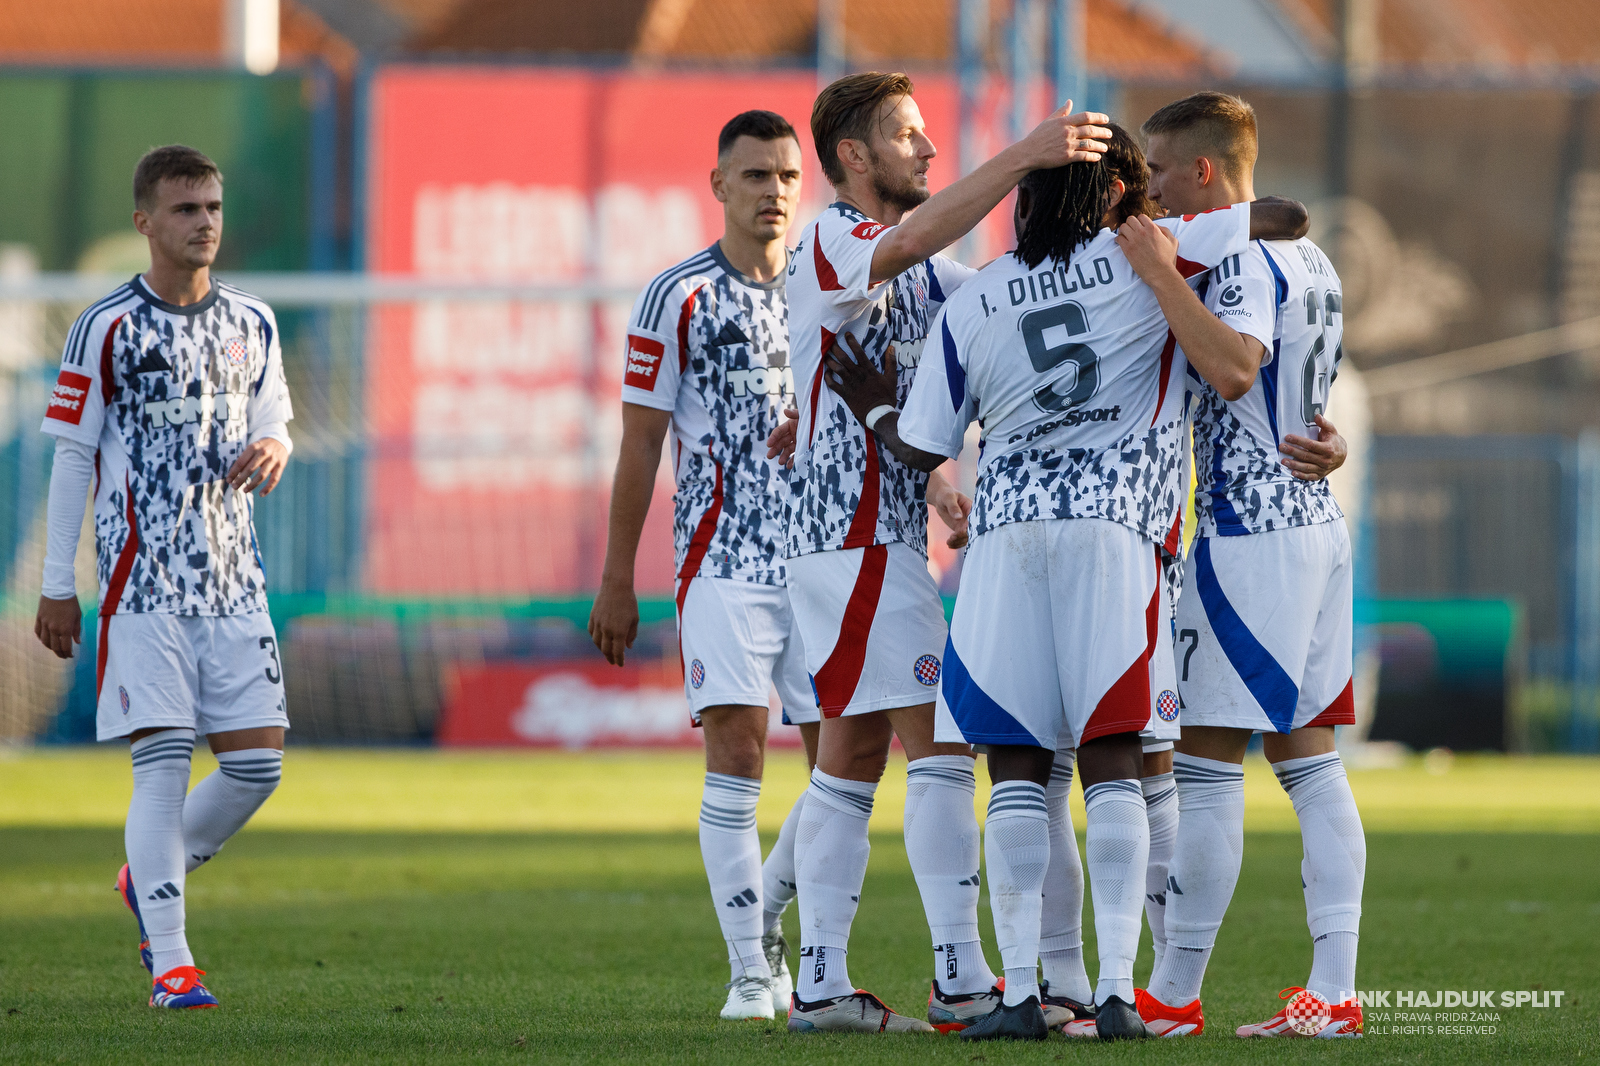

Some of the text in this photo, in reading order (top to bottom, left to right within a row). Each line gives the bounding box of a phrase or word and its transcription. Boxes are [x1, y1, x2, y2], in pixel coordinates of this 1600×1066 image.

[1007, 256, 1114, 306] DIALLO
[1017, 299, 1101, 414] 5
[725, 366, 795, 397] TOM
[144, 391, 249, 429] TOMMY
[259, 636, 281, 684] 3
[1173, 628, 1199, 682] 7
